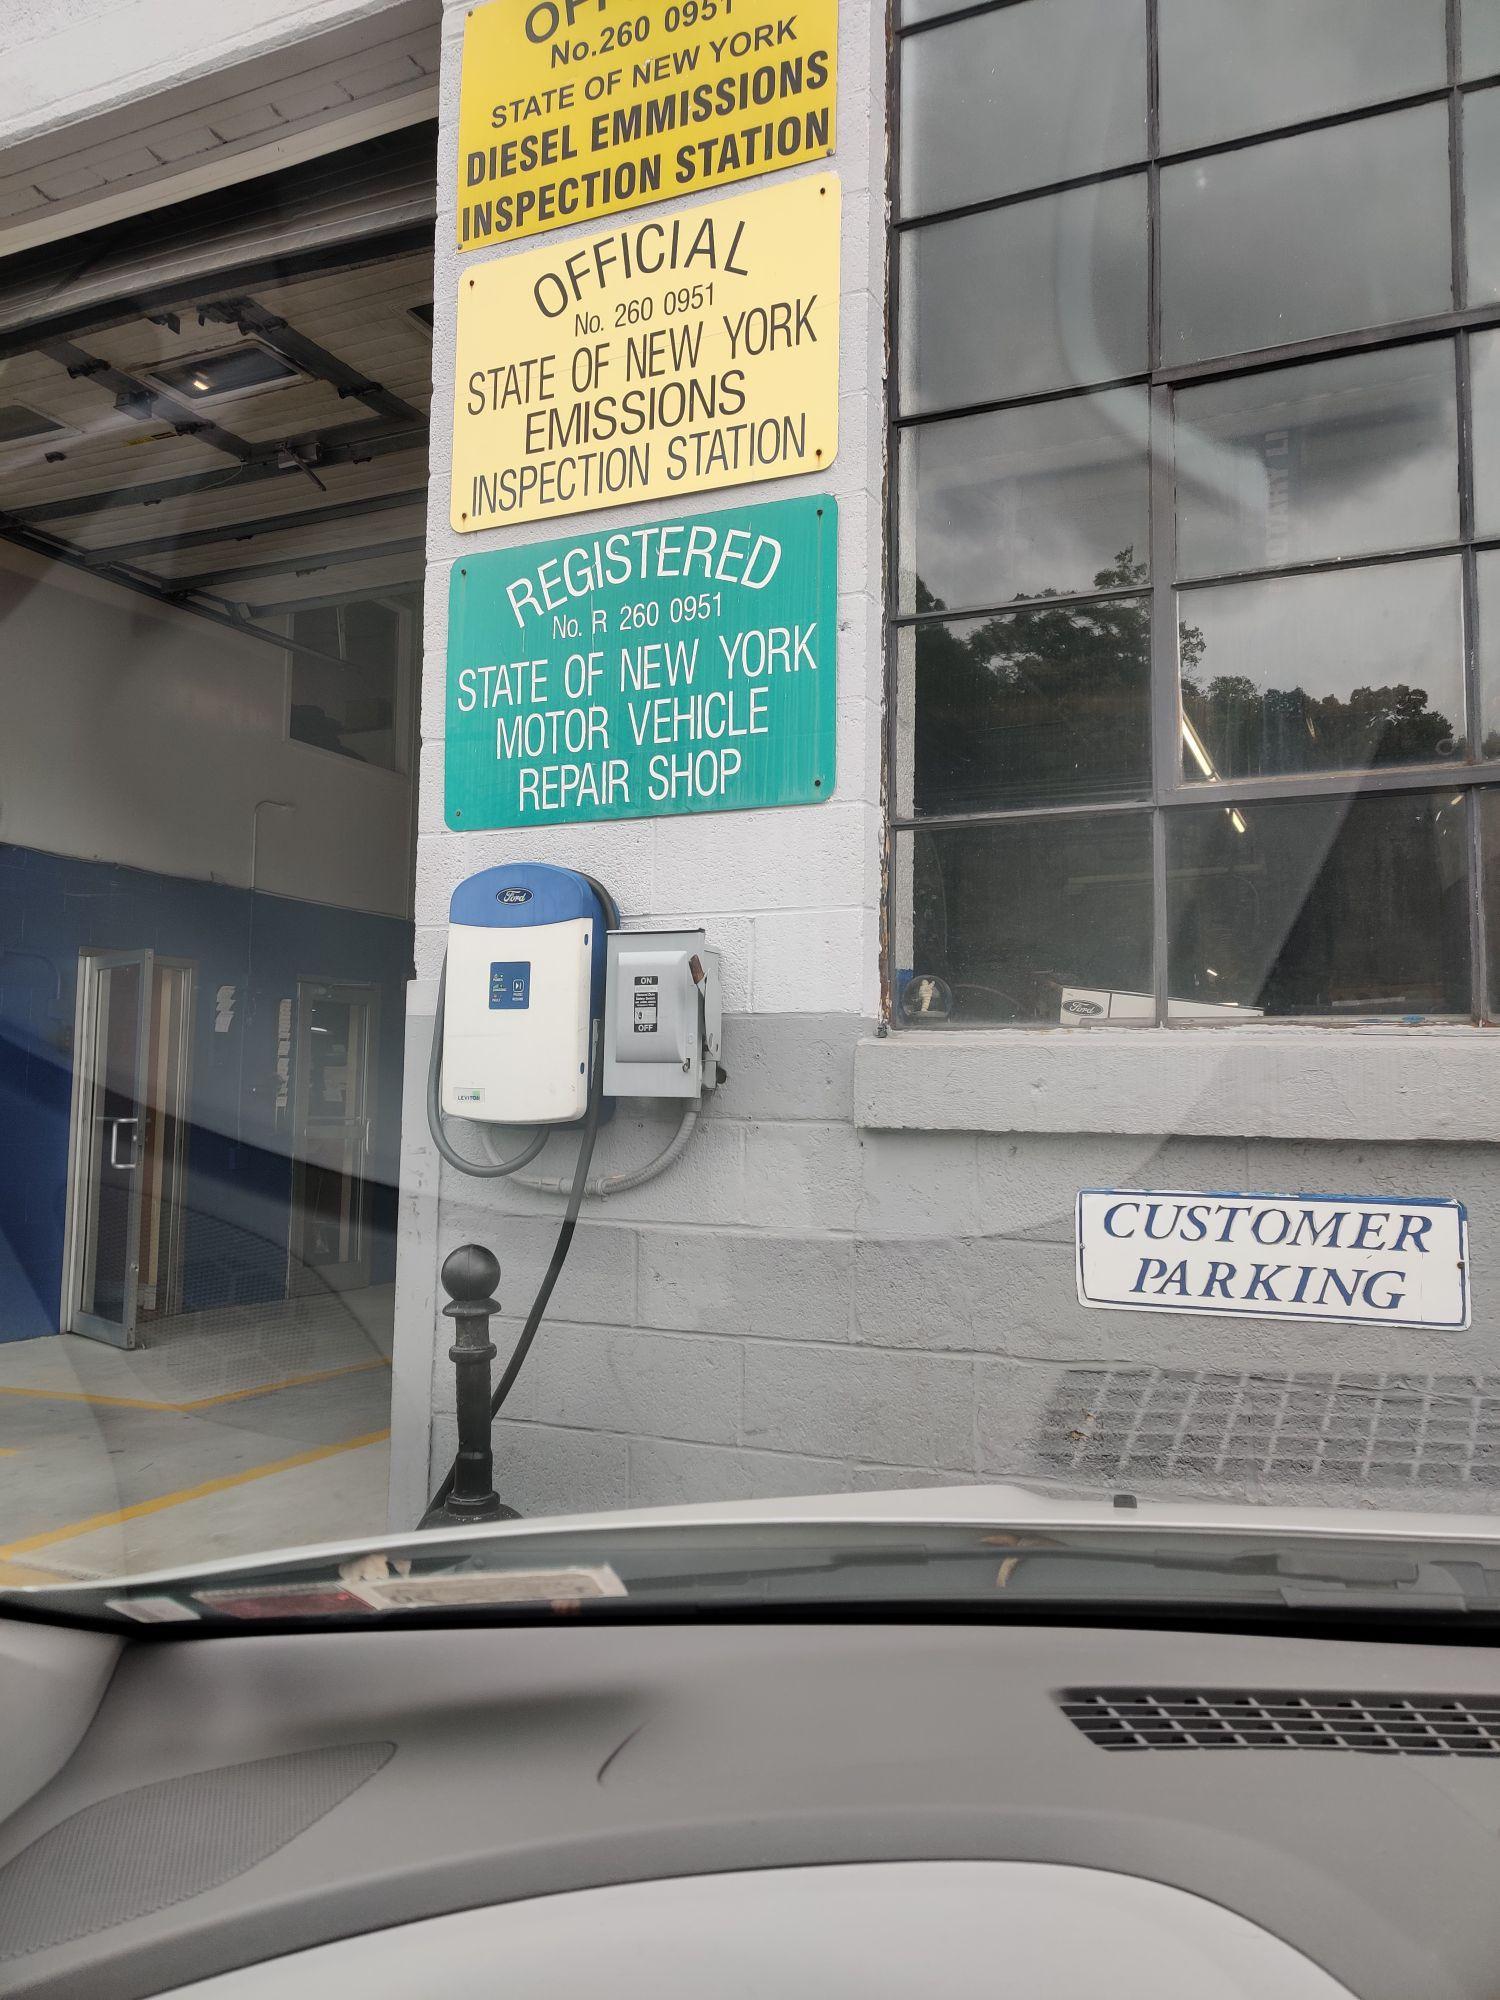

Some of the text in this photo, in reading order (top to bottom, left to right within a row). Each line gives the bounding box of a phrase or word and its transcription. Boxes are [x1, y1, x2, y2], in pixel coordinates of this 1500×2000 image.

[491, 15, 798, 129] STATE OF NEW YORK
[466, 50, 829, 187] DIESEL EMMISSIONS
[462, 107, 829, 242] INSPECTION STATION
[533, 217, 750, 318] OFFICIAL
[574, 281, 714, 337] No. 260 0951
[467, 294, 819, 416] STATE OF NEW YORK
[525, 369, 746, 455] EMISSIONS
[471, 412, 806, 517] INSPECTION STATION
[505, 525, 782, 628] REGISTERED
[552, 591, 722, 640] No. R 260 0951
[457, 622, 818, 712] STATE OF NEW YORK
[496, 686, 769, 760] MOTOR VEHICLE
[519, 748, 742, 812] REPAIR SHOP
[503, 890, 527, 902] Ford
[640, 977, 653, 985] ON
[1070, 1001, 1096, 1014] Ford
[638, 1024, 654, 1032] OFF
[1103, 1202, 1434, 1253] CUSTOMER
[1128, 1257, 1407, 1310] PARKING
